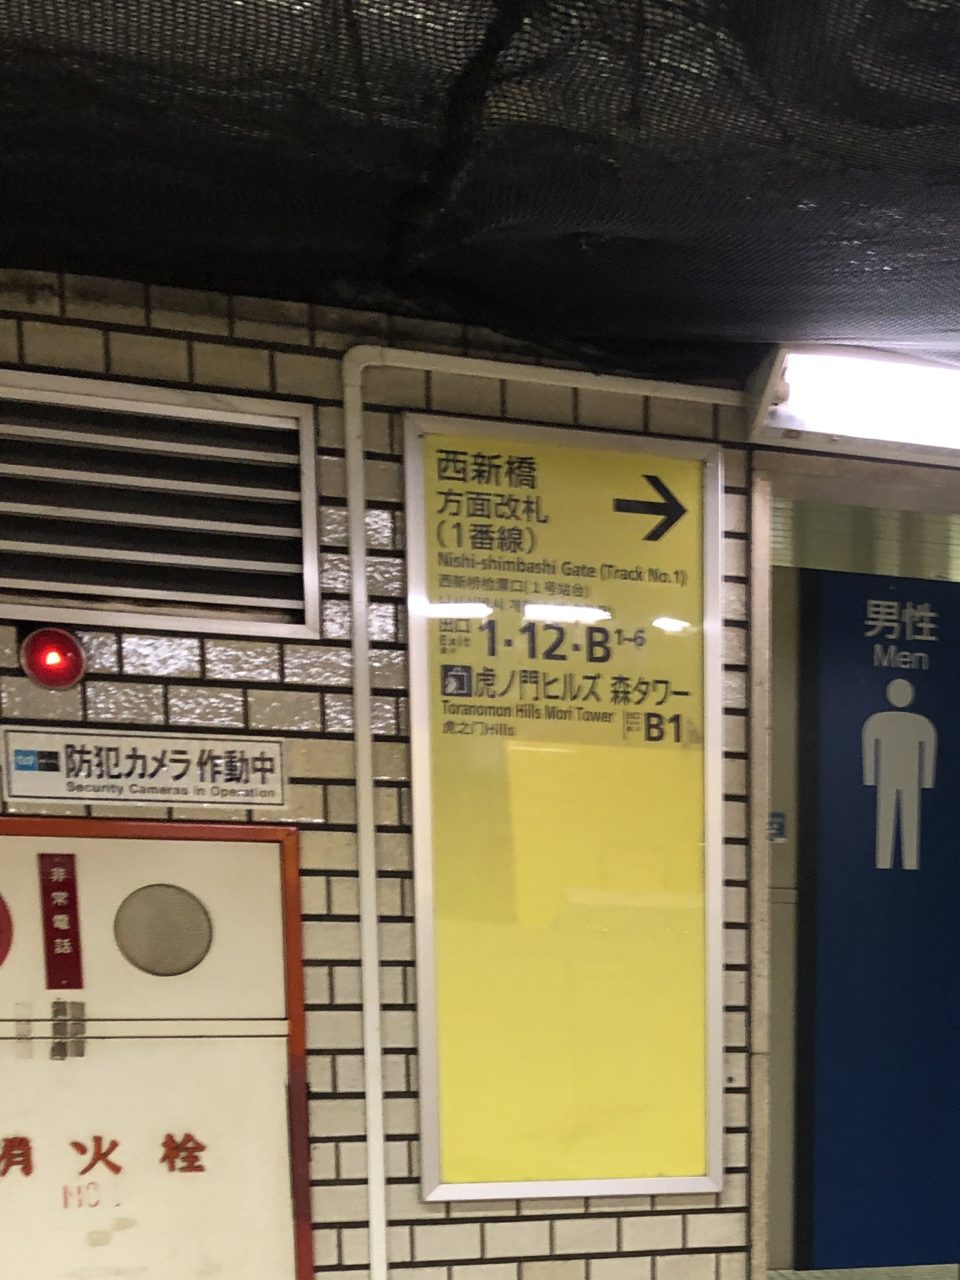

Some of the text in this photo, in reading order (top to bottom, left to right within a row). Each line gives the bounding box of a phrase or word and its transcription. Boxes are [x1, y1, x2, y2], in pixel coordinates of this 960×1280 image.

[436, 449, 537, 489] 西新橋
[437, 489, 549, 524] 方面改札
[438, 551, 556, 575] Nishi-shimbashi
[561, 561, 596, 578] Gate
[600, 563, 643, 582] (Track
[863, 600, 939, 641] 男性
[873, 644, 929, 670] Men
[475, 667, 690, 706] 虎ノ門ヒルズ 森タワー
[515, 703, 541, 720] Hills
[576, 706, 614, 723] Tower
[644, 712, 681, 743] B1
[66, 781, 275, 798] Security Cameras in Operation
